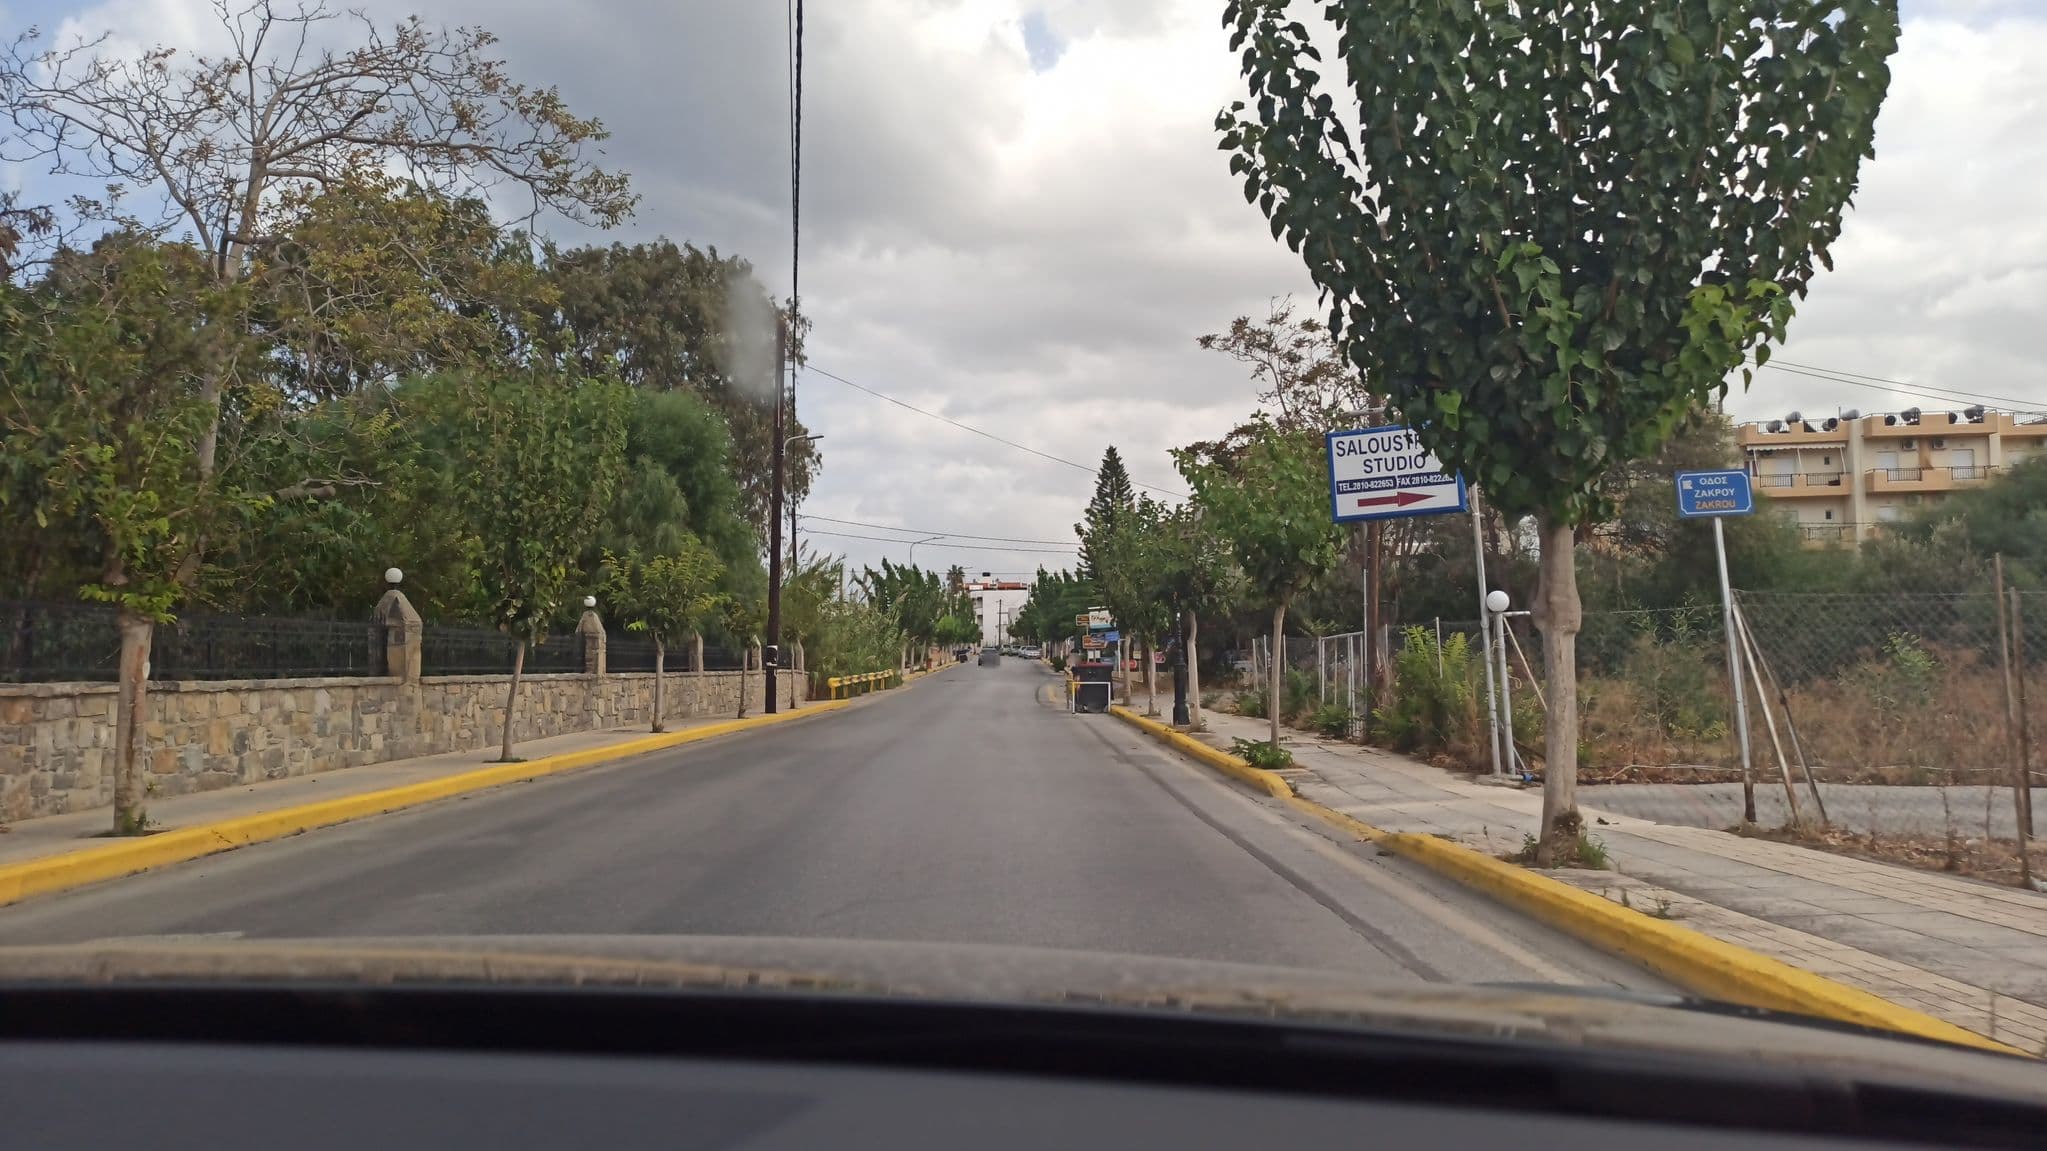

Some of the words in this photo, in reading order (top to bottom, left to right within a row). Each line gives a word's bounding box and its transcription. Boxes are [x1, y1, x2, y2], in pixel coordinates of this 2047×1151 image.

[1363, 454, 1426, 474] STUDIO
[1397, 477, 1411, 487] FAX
[1699, 476, 1728, 485] ΟΔΟΣ
[1694, 488, 1735, 498] ΖΑΚΡΟΥ
[1695, 500, 1736, 510] ZAKROU
